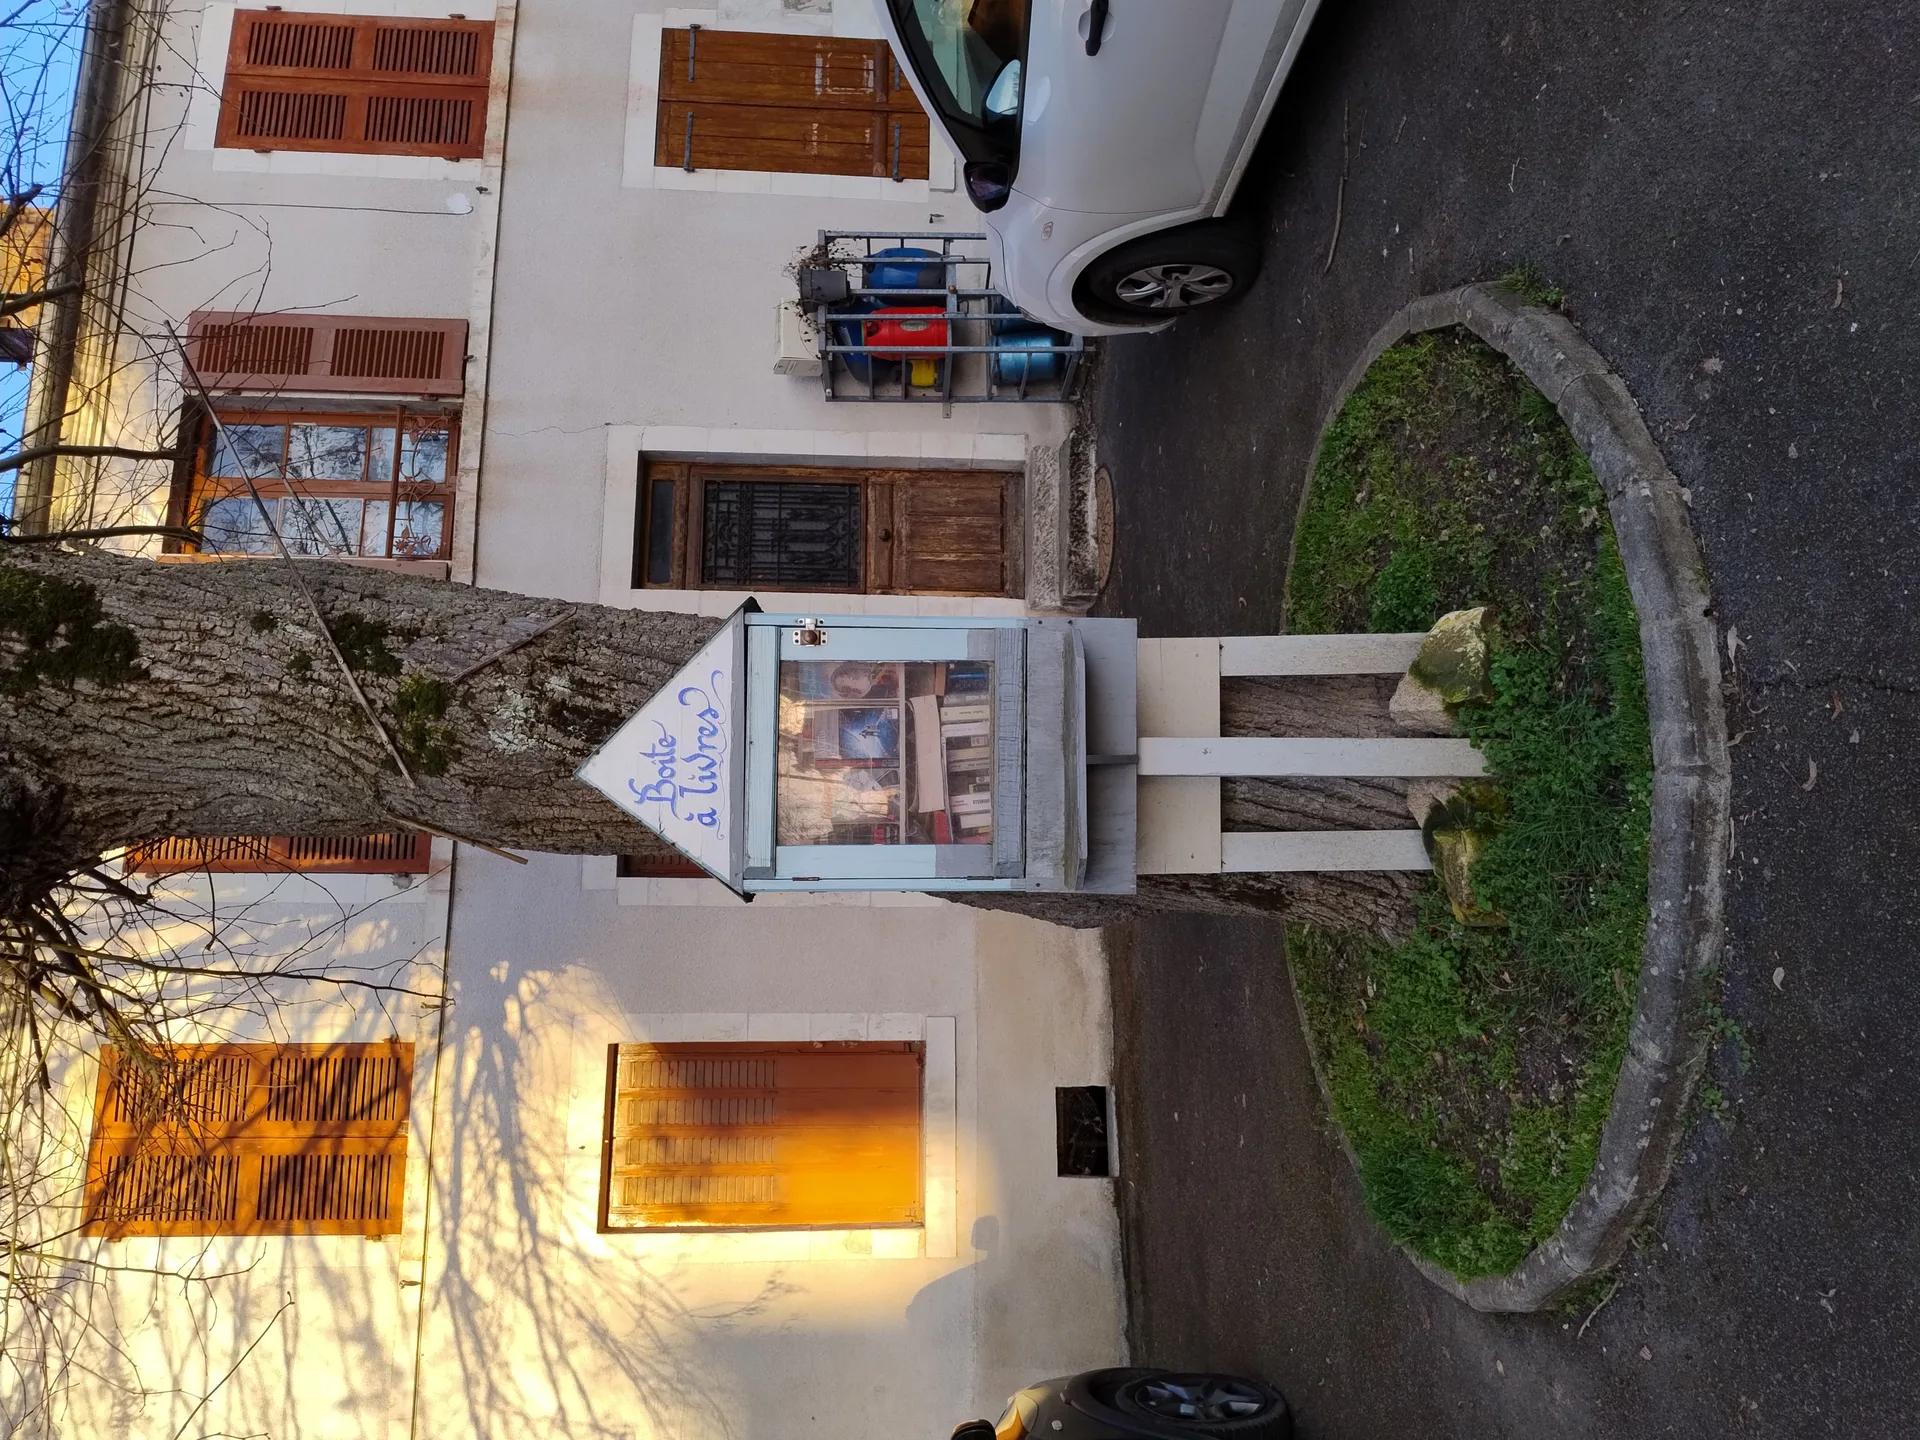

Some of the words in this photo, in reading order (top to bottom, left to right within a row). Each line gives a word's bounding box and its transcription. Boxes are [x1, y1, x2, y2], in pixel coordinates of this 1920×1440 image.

[628, 719, 680, 820] Boîte
[678, 687, 719, 798] livres
[684, 806, 718, 827] à
